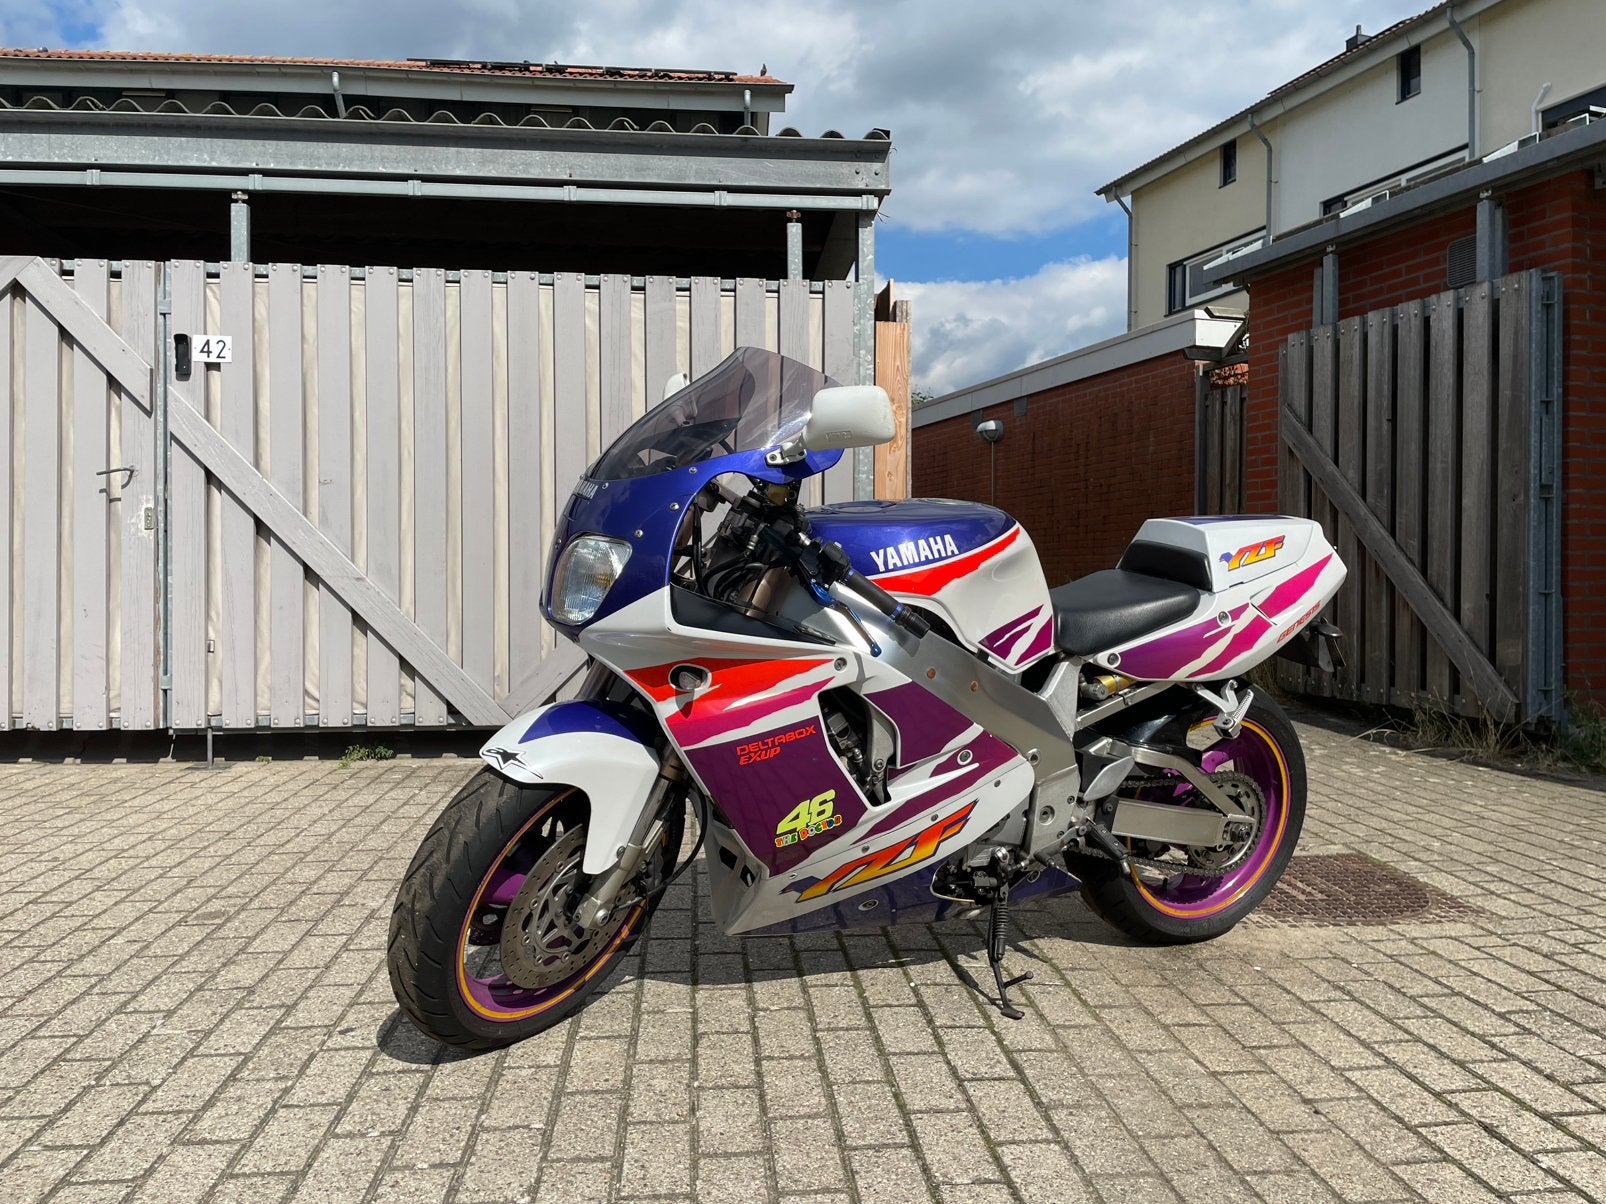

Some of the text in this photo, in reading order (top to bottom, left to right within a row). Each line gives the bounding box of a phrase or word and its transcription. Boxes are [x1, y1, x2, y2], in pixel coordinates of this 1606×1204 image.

[199, 339, 226, 359] 42
[870, 534, 959, 572] YAMAHA
[1219, 535, 1286, 572] YZF
[1277, 600, 1321, 643] GENESIS
[736, 725, 816, 755] DELTABOX
[739, 746, 781, 765] EXUP
[776, 788, 836, 835] 46
[775, 814, 843, 848] THE DOCTOR
[778, 798, 979, 904] YZF
